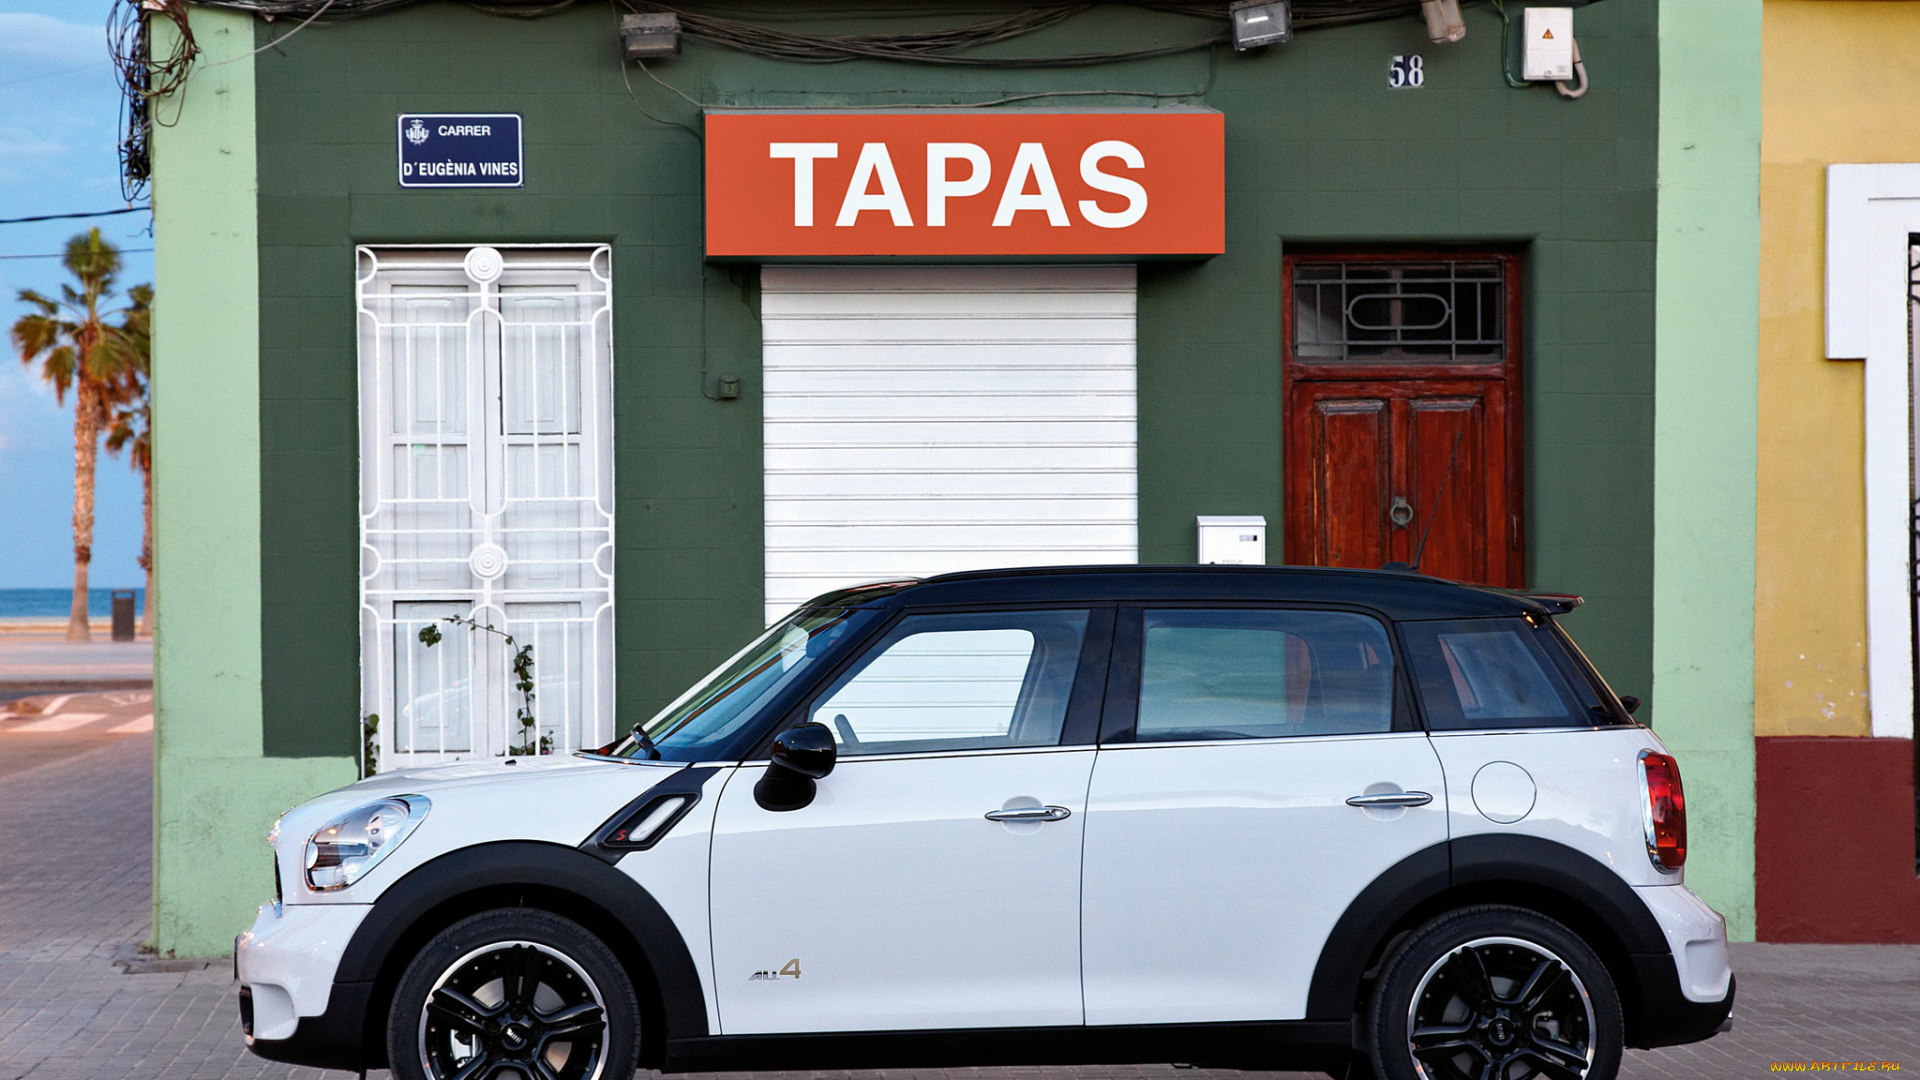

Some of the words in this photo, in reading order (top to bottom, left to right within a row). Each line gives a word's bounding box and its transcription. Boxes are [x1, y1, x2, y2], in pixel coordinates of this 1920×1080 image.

[1390, 55, 1424, 87] 58
[438, 125, 491, 136] CARRER
[479, 162, 518, 176] VINES
[769, 140, 1148, 228] TAPAS
[616, 829, 627, 841] S
